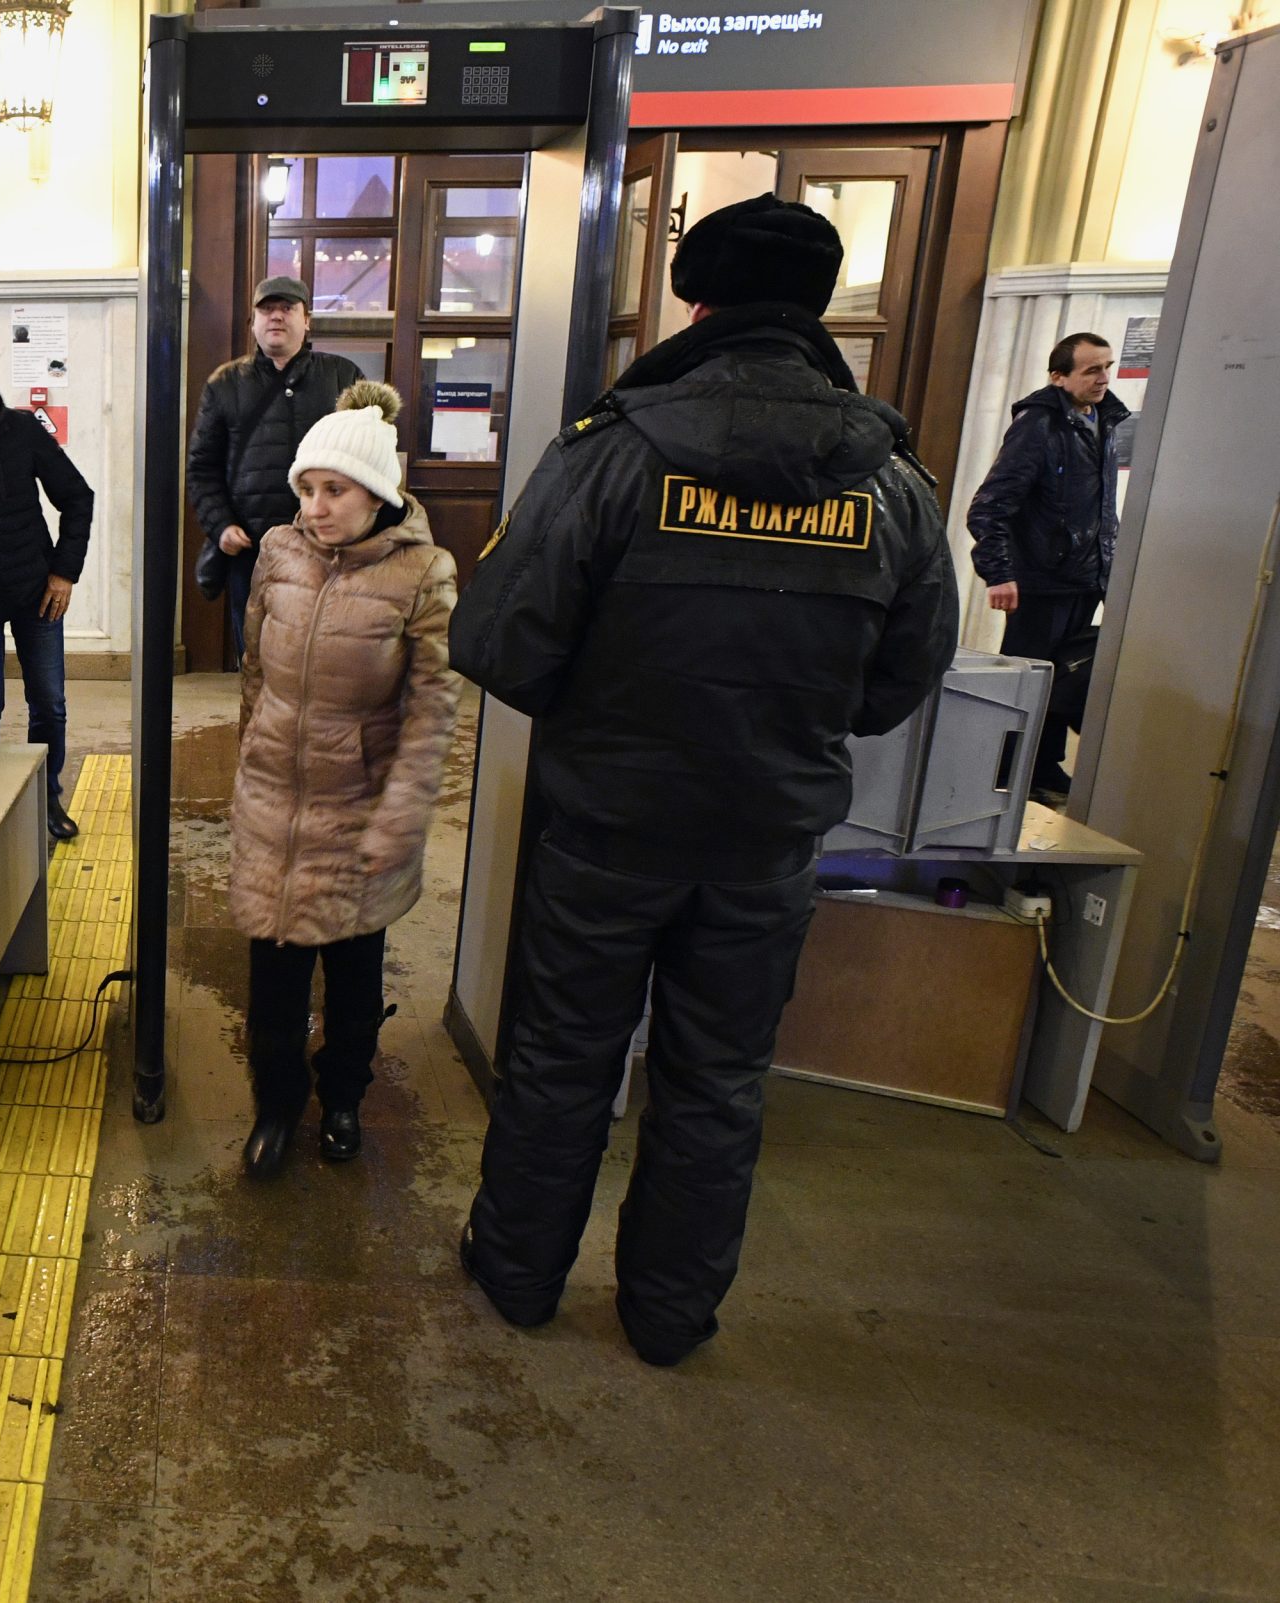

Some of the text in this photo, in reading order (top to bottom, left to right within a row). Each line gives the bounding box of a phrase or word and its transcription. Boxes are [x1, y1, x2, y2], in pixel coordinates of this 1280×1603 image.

[658, 9, 823, 35] Выход запрещён
[657, 38, 709, 54] No exit
[678, 485, 856, 538] РЖД-ОХРАНА
